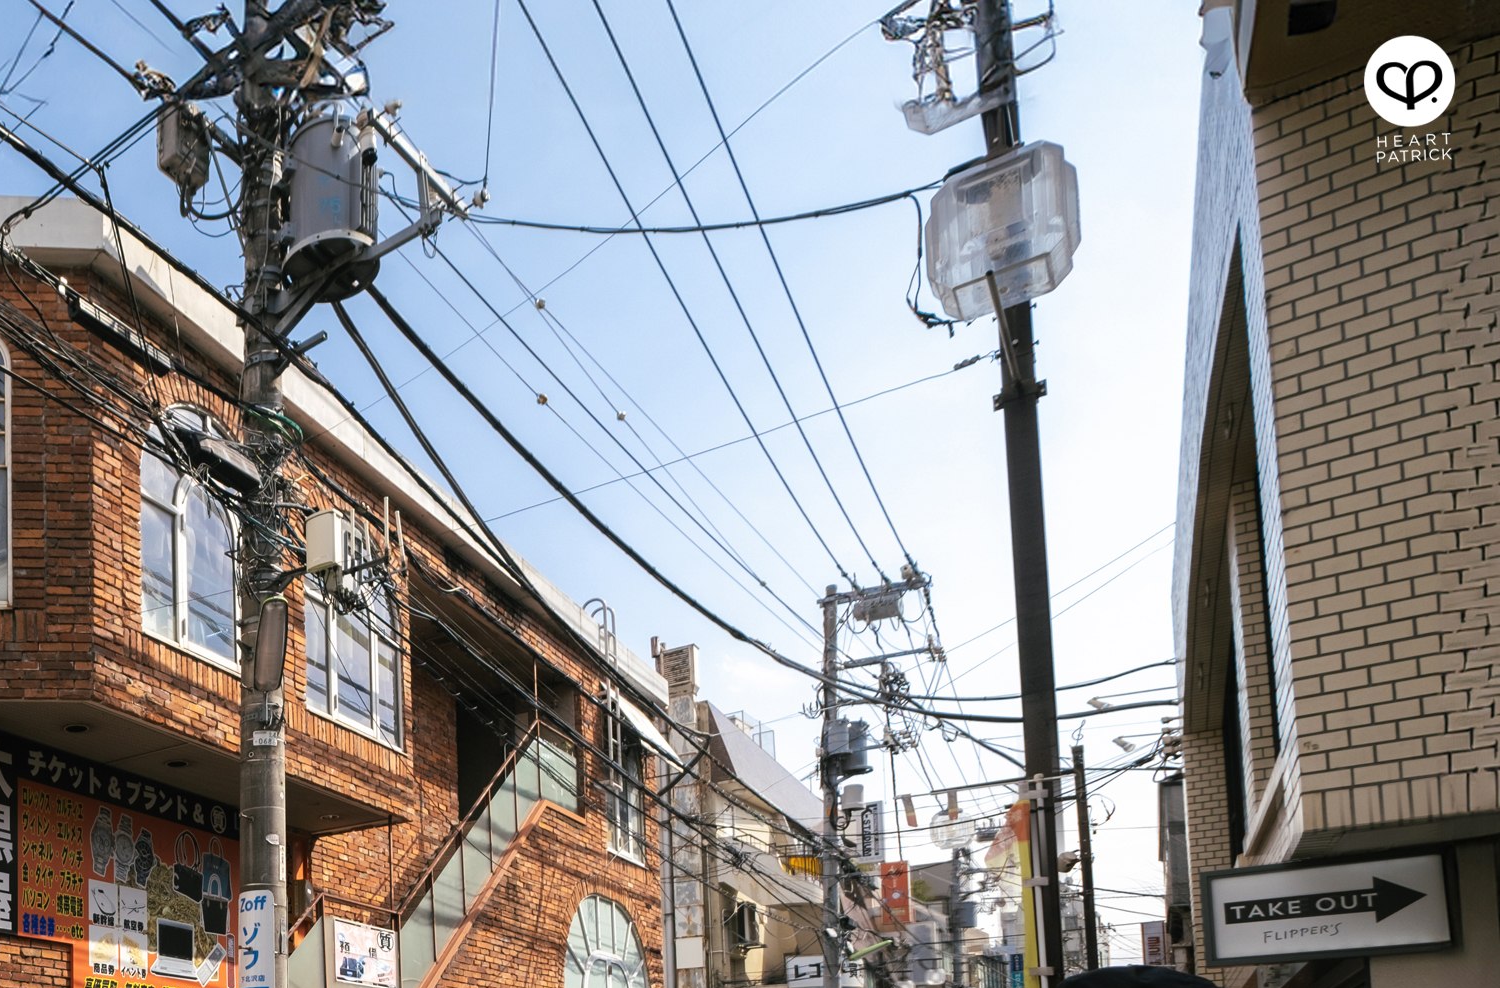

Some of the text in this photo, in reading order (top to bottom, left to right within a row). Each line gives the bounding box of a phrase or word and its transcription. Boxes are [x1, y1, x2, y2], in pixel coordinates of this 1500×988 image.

[22, 811, 84, 844] ヴィトン・エルメス
[22, 835, 84, 869] シャネル・グッチ
[22, 862, 84, 893] 金・ダイヤ・プラチナ
[22, 886, 84, 918] パソコン・携帯電話
[240, 895, 267, 913] Zoff
[1230, 892, 1378, 920] TAKE OUT
[92, 913, 115, 926] 新幹線
[123, 918, 144, 932] 航空券
[379, 932, 392, 951] 質
[1263, 922, 1342, 944] FLIPPER'S
[242, 922, 261, 970] ゾフ
[93, 963, 115, 975] 商品券
[120, 967, 147, 980] イベント券
[241, 974, 265, 983] 下北沢店
